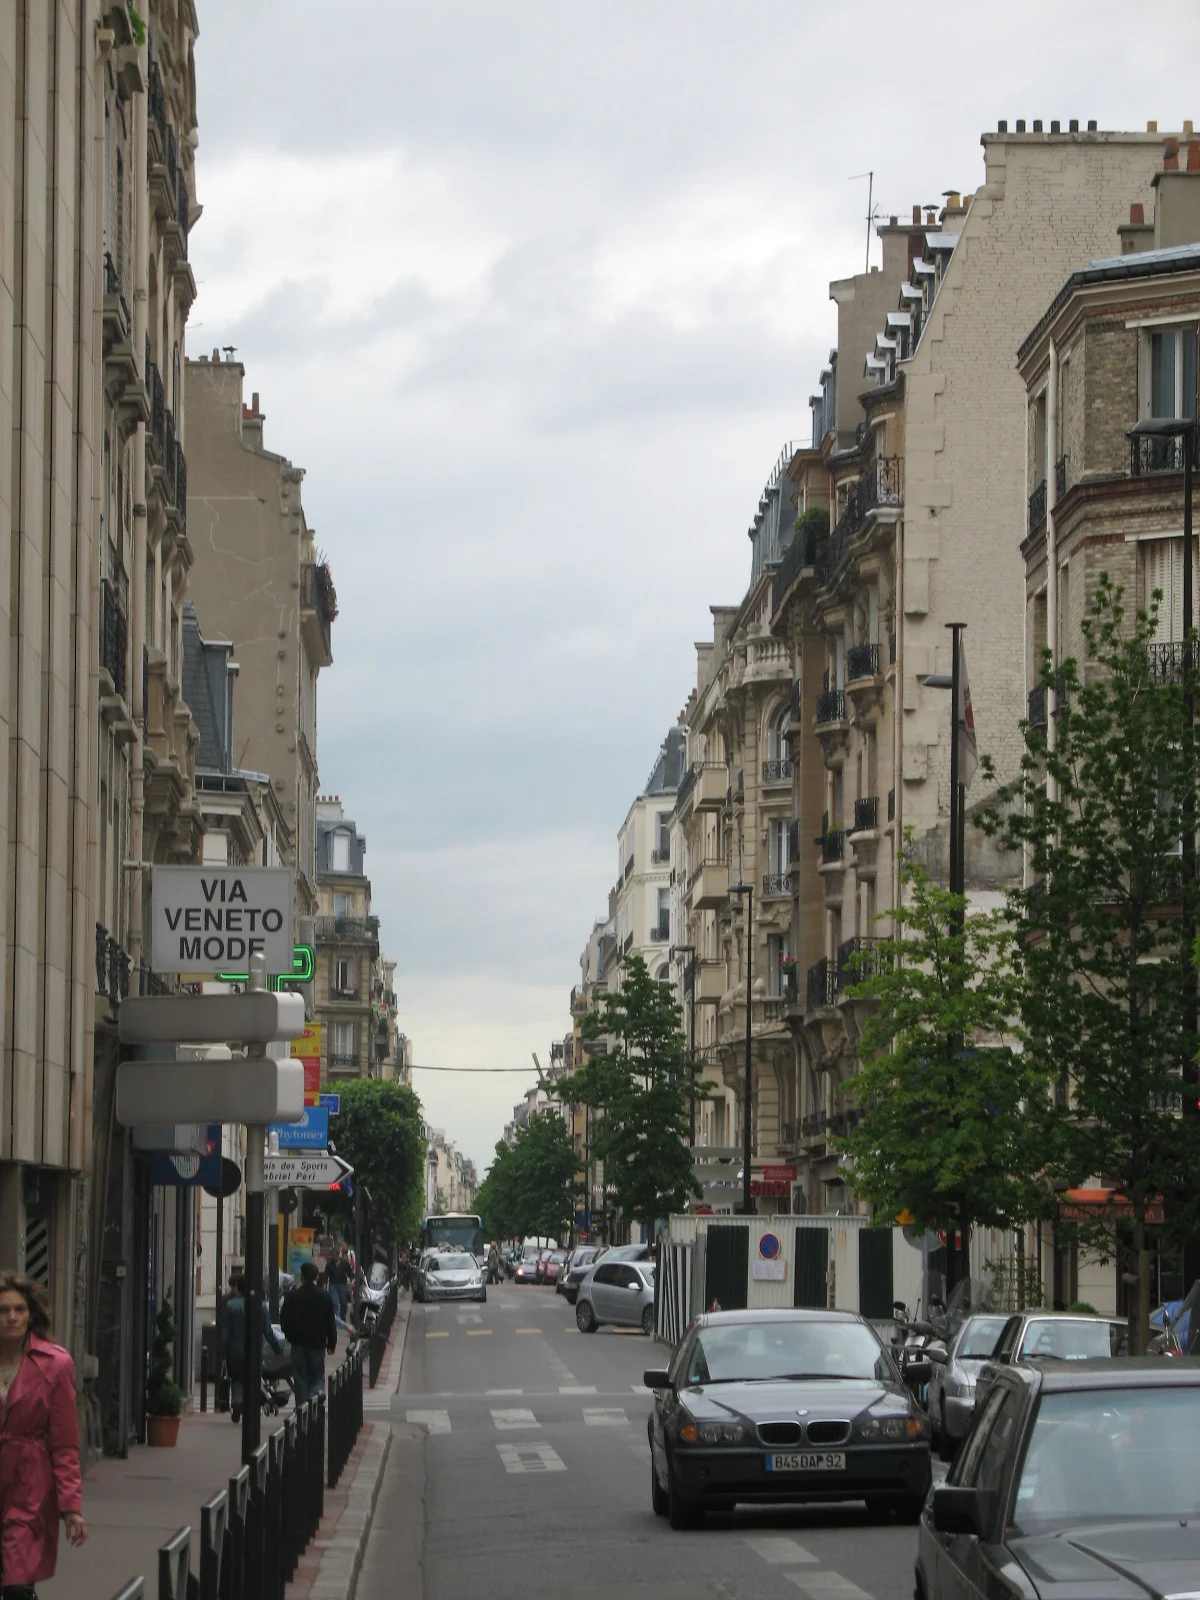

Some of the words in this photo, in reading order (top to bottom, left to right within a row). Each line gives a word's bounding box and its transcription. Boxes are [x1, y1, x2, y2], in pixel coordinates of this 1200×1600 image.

[201, 879, 247, 902] VIA
[164, 908, 283, 932] VENETO
[180, 936, 265, 960] MODE
[264, 1161, 276, 1170] ais
[281, 1161, 295, 1170] des
[301, 1161, 328, 1172] Sports
[264, 1172, 291, 1180] abriel
